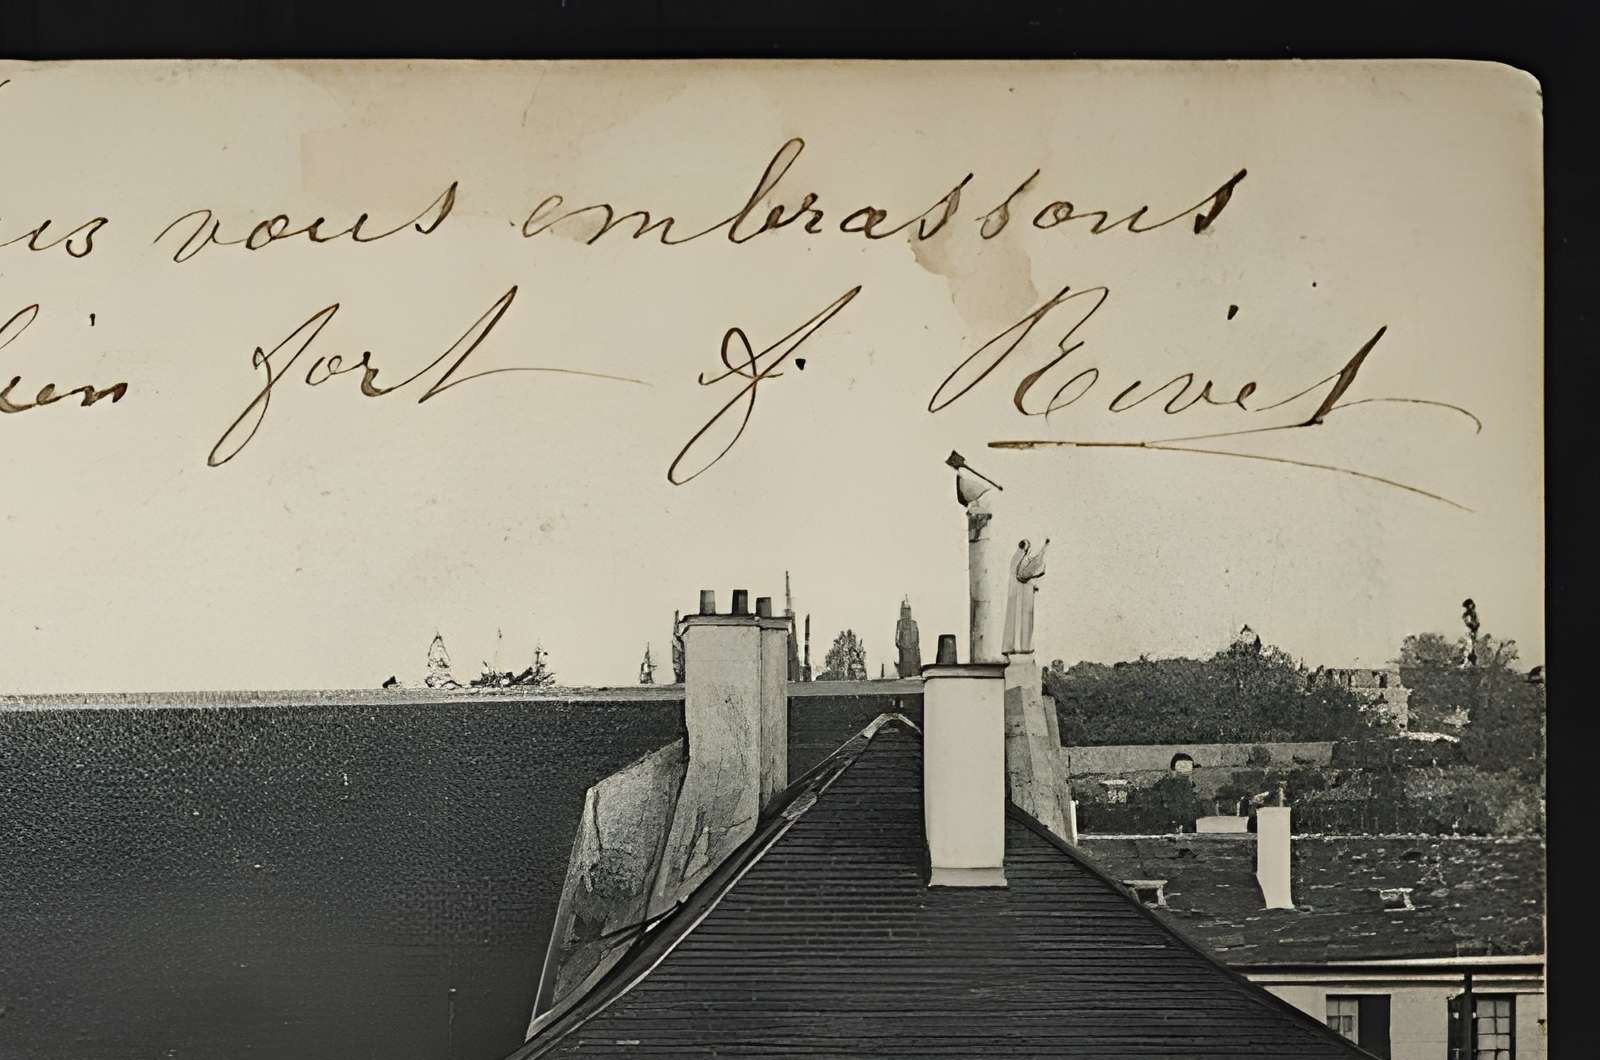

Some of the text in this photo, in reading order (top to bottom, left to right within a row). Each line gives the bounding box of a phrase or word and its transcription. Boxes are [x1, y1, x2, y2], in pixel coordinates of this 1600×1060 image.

[152, 180, 460, 264] vous
[520, 137, 1248, 244] embrassons
[206, 285, 650, 467] fort
